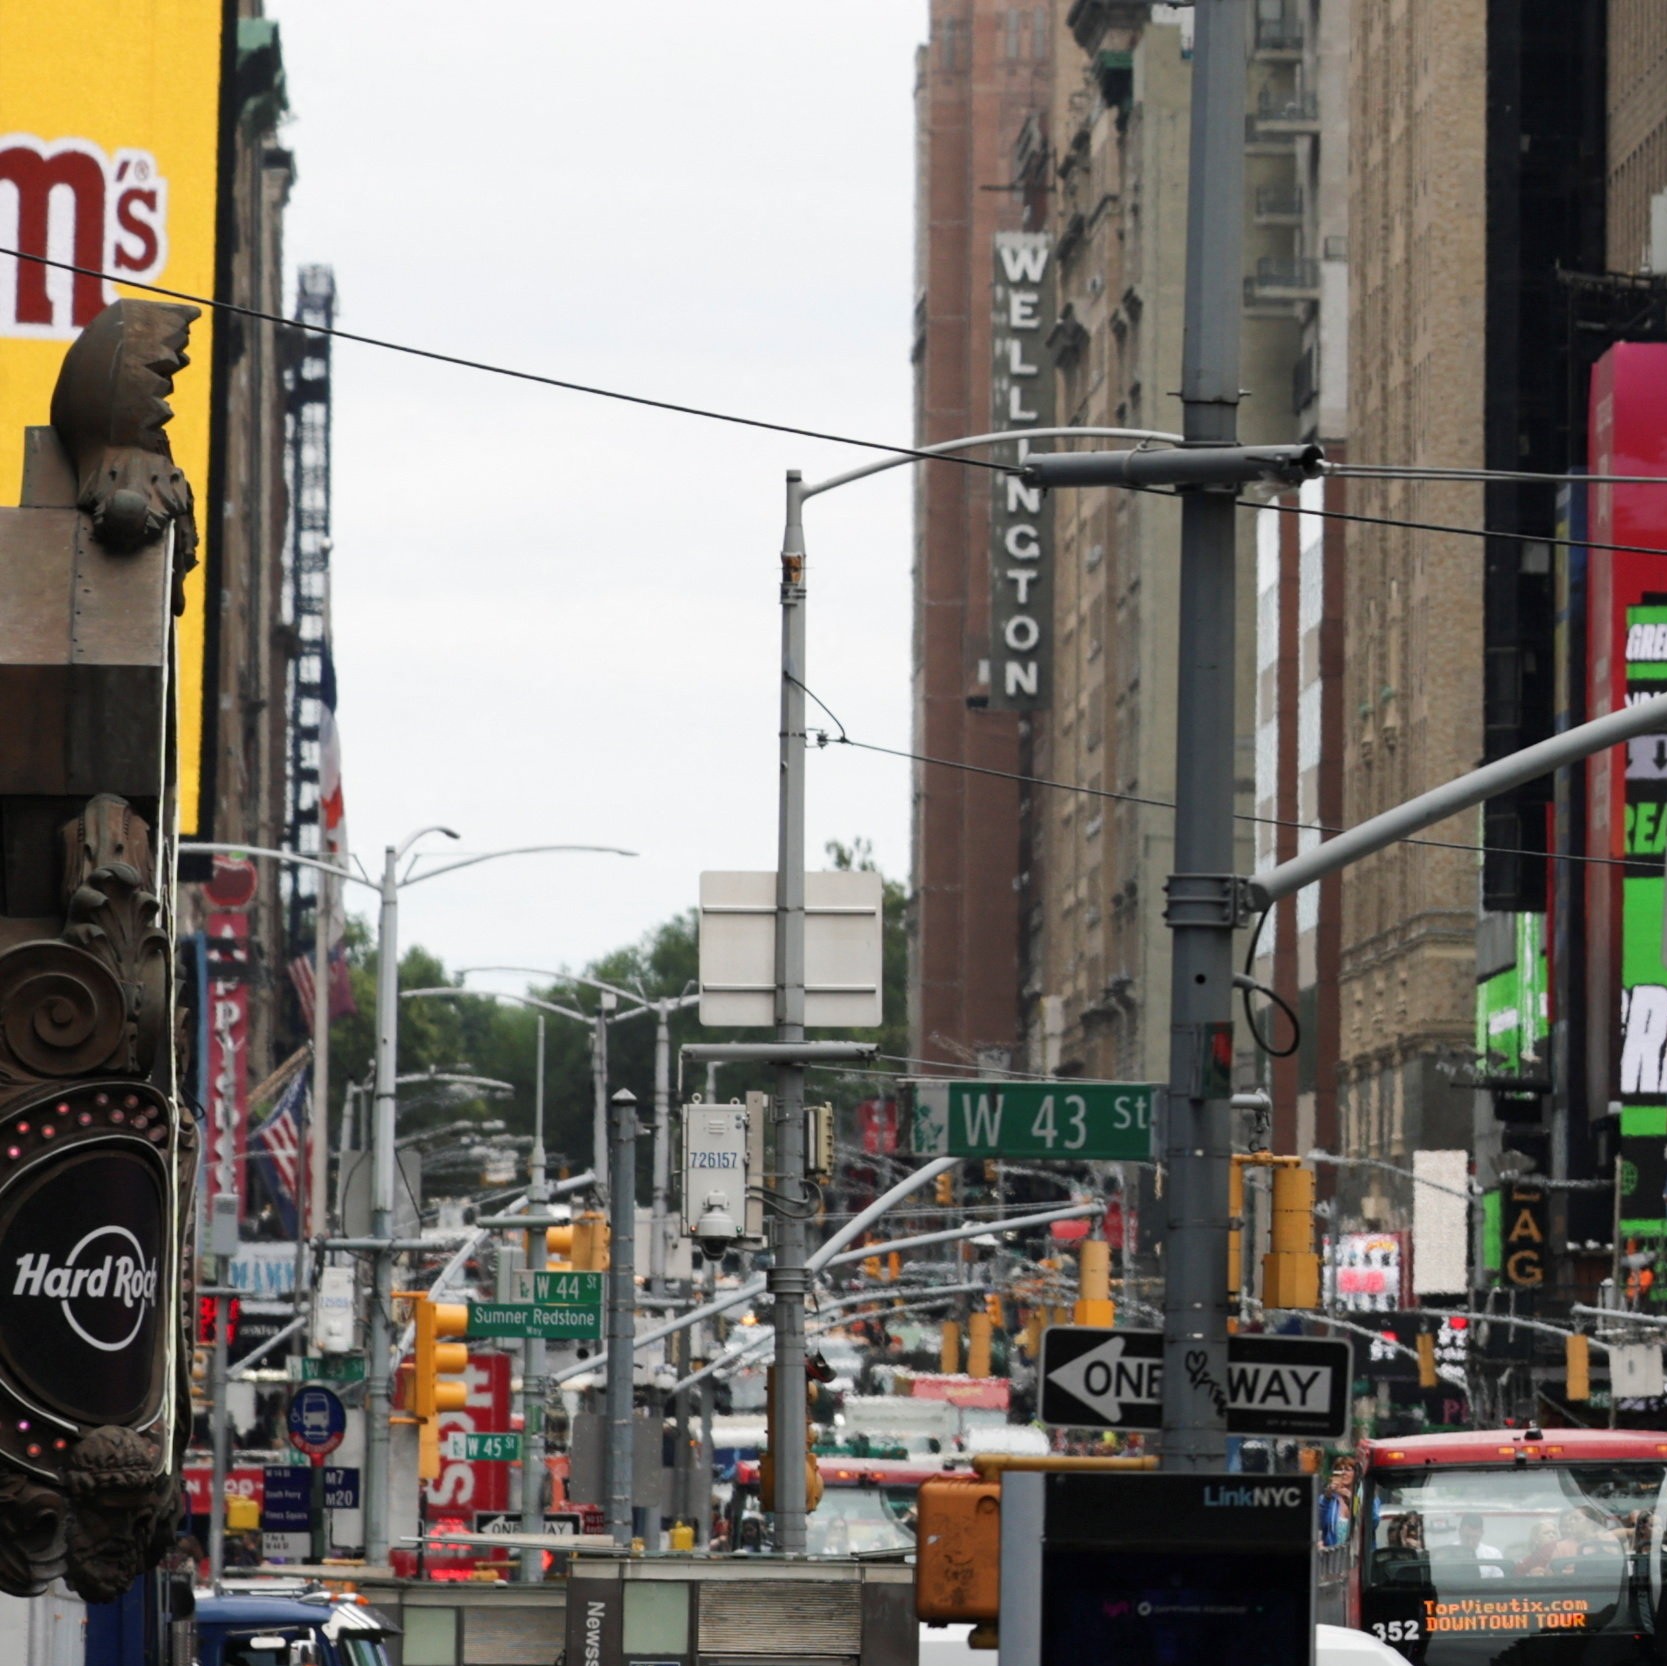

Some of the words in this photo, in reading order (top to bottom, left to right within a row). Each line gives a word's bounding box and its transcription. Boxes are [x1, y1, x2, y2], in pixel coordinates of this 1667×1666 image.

[963, 1099, 1001, 1148] W
[1031, 1098, 1087, 1150] 43
[1113, 1097, 1146, 1131] St
[689, 1151, 738, 1169] 726157
[14, 1254, 110, 1298] Hard
[537, 1276, 550, 1298] W
[556, 1275, 580, 1300] 44
[586, 1272, 597, 1289] St
[474, 1306, 528, 1325] Sumner
[533, 1308, 595, 1326] Redstone
[1084, 1361, 1163, 1398] ONE
[1227, 1367, 1321, 1407] WAY
[467, 1438, 479, 1457] W
[484, 1437, 501, 1457] 45
[325, 1470, 345, 1486] M7
[325, 1490, 354, 1507] M20
[1204, 1485, 1301, 1508] LinkNYC
[1424, 1600, 1588, 1615] TopViewtix.com
[1372, 1620, 1420, 1641] 352
[1425, 1614, 1528, 1632] DOWNTOWN
[1537, 1613, 1586, 1628] TOUR
